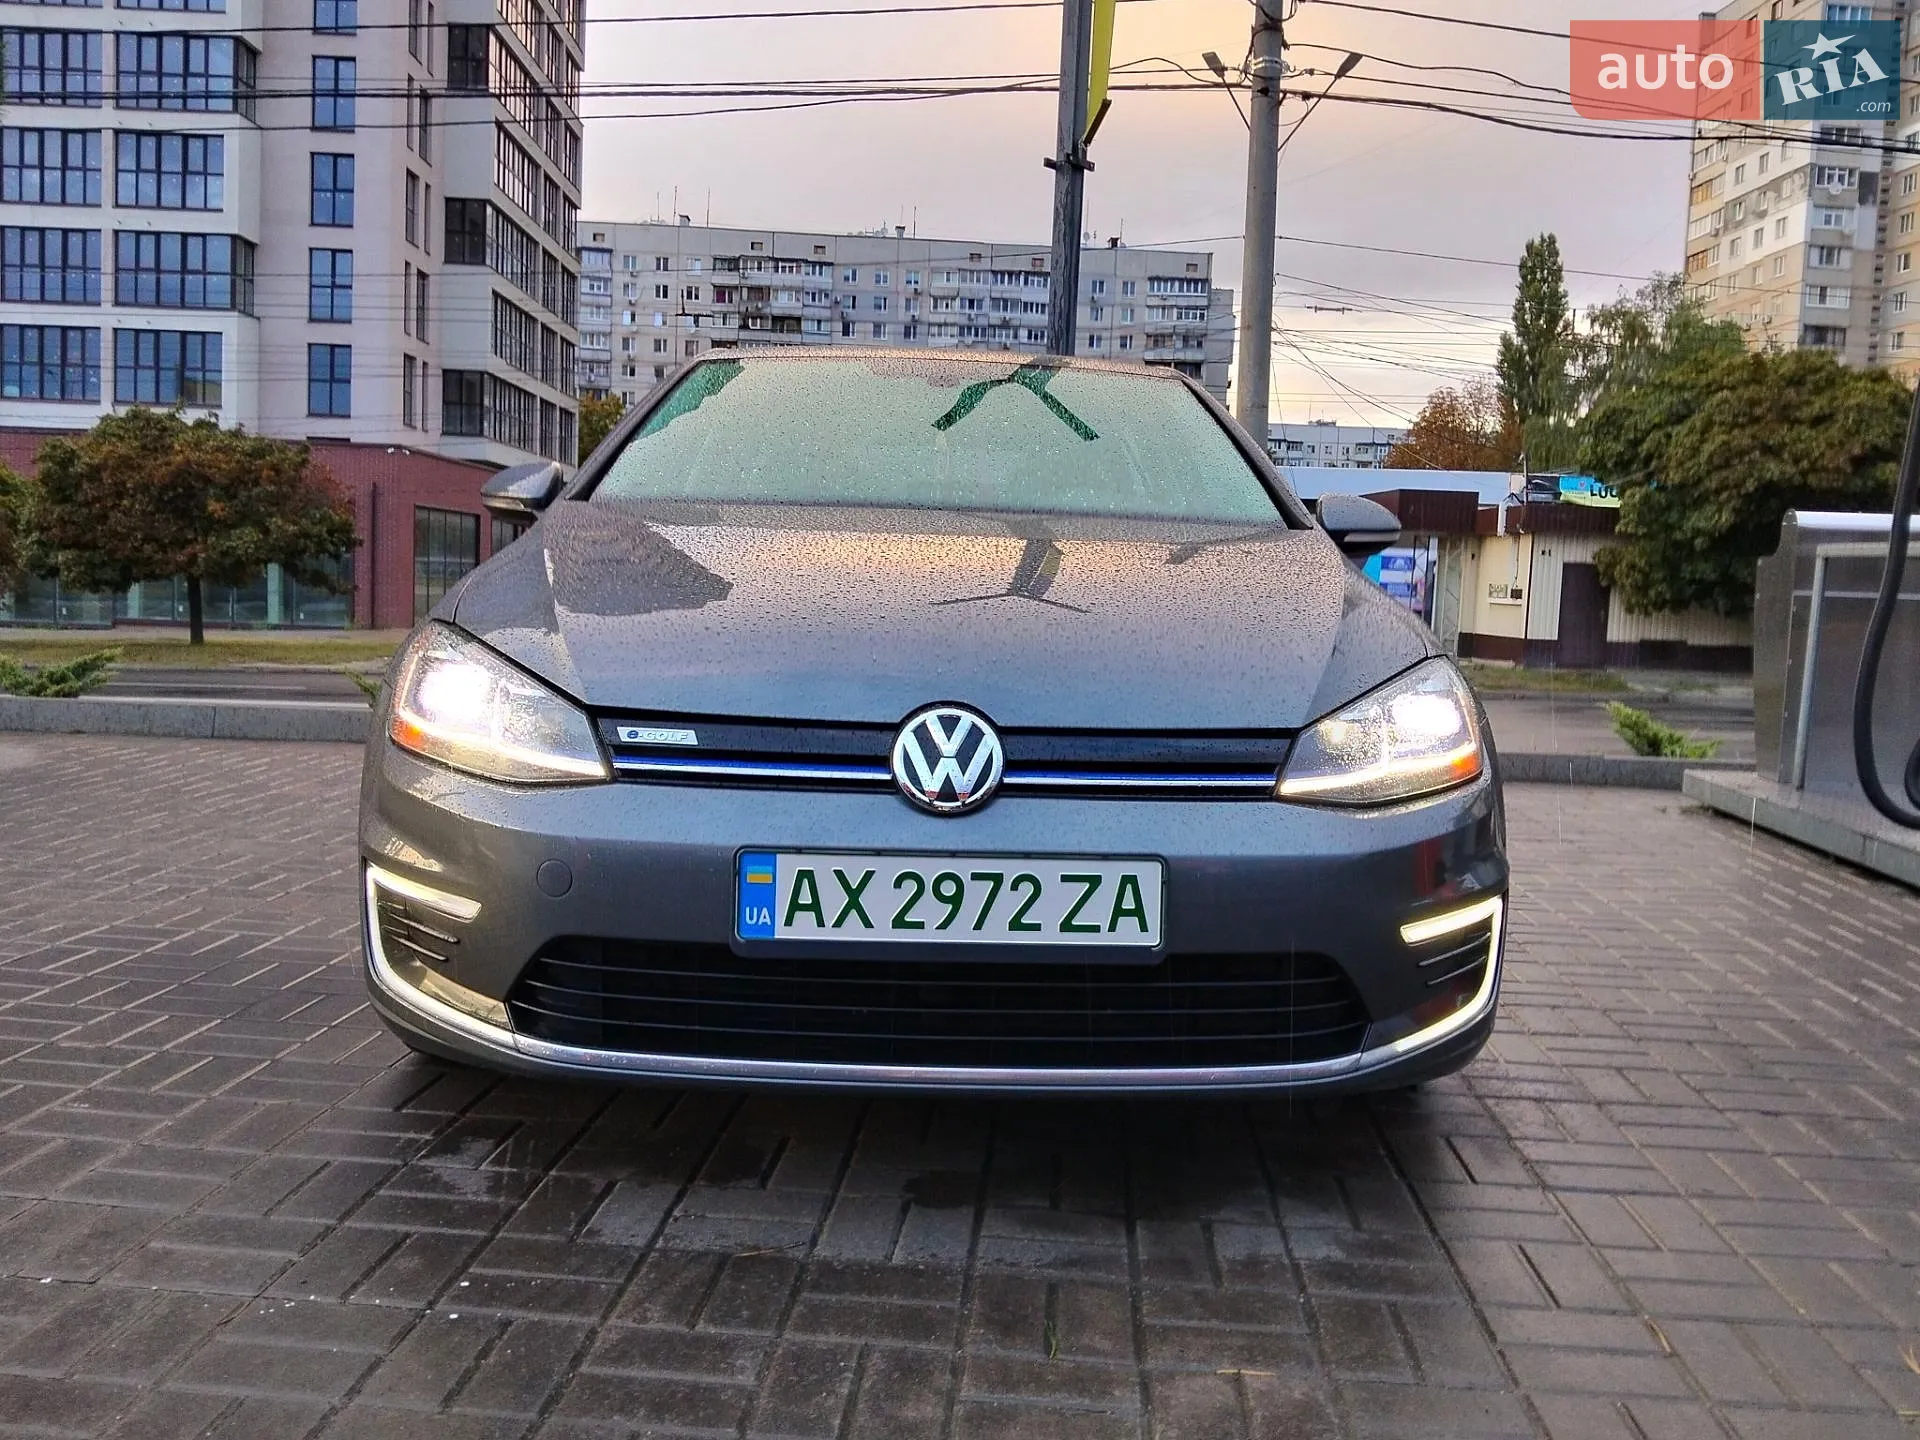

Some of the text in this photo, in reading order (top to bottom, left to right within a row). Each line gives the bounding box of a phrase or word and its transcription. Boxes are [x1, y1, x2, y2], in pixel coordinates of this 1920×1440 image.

[897, 710, 1000, 805] VW
[745, 906, 771, 925] UA
[783, 868, 1149, 933] AX 2972 ZA
